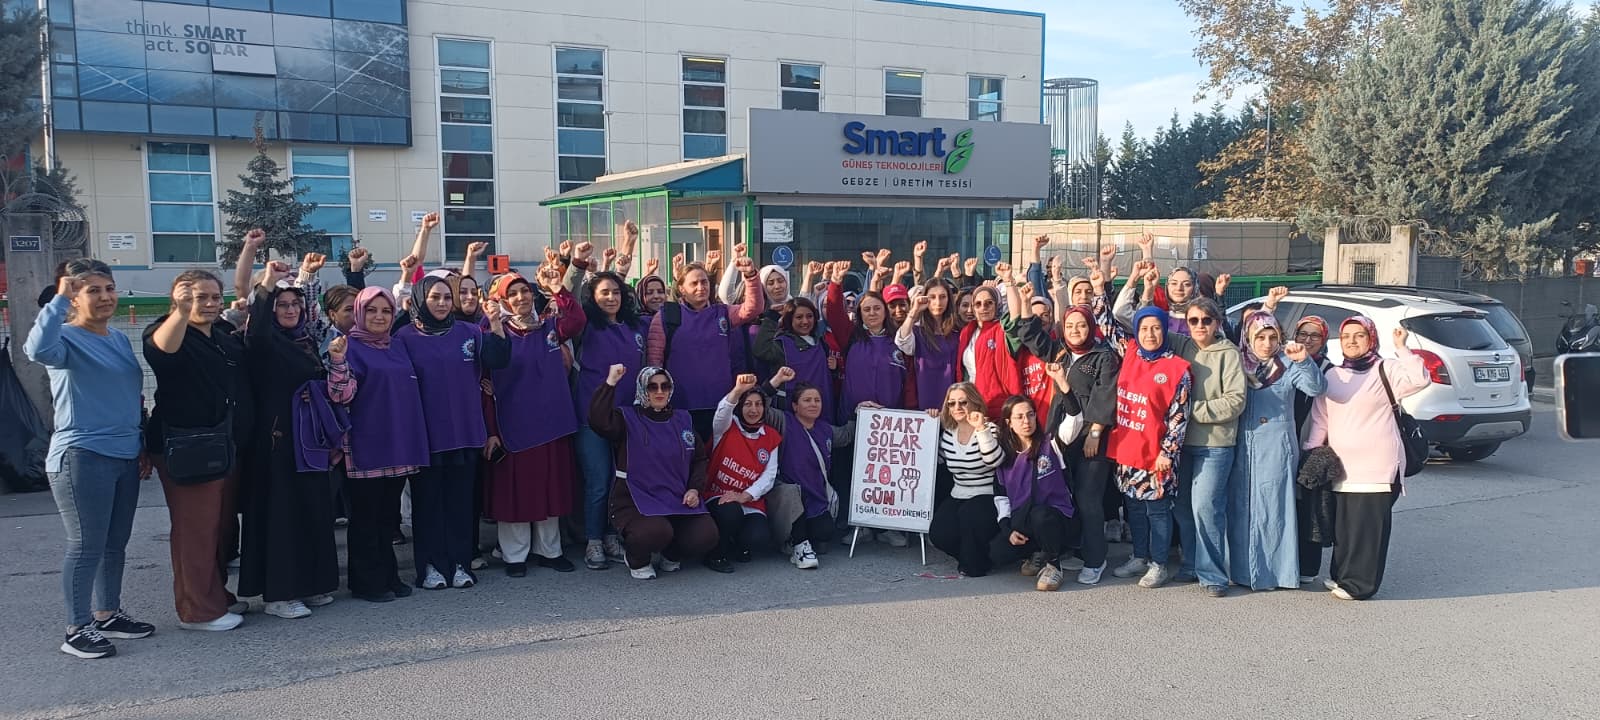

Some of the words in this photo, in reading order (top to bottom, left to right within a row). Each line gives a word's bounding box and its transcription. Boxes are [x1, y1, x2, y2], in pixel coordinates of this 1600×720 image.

[125, 19, 177, 37] think.
[183, 24, 247, 42] SMART
[145, 39, 179, 53] act.
[185, 40, 249, 57] SOLAR
[842, 121, 947, 158] Smart
[842, 159, 873, 171] GÜNEŞ
[842, 177, 879, 186] GEBZE
[892, 177, 934, 188] ÜRETİM
[939, 178, 972, 188] TESİSİ
[870, 413, 925, 434] SMART
[867, 430, 923, 450] SOLAR
[867, 446, 916, 466] GREVİ
[862, 463, 896, 487] 10.
[861, 486, 896, 505] GÜN
